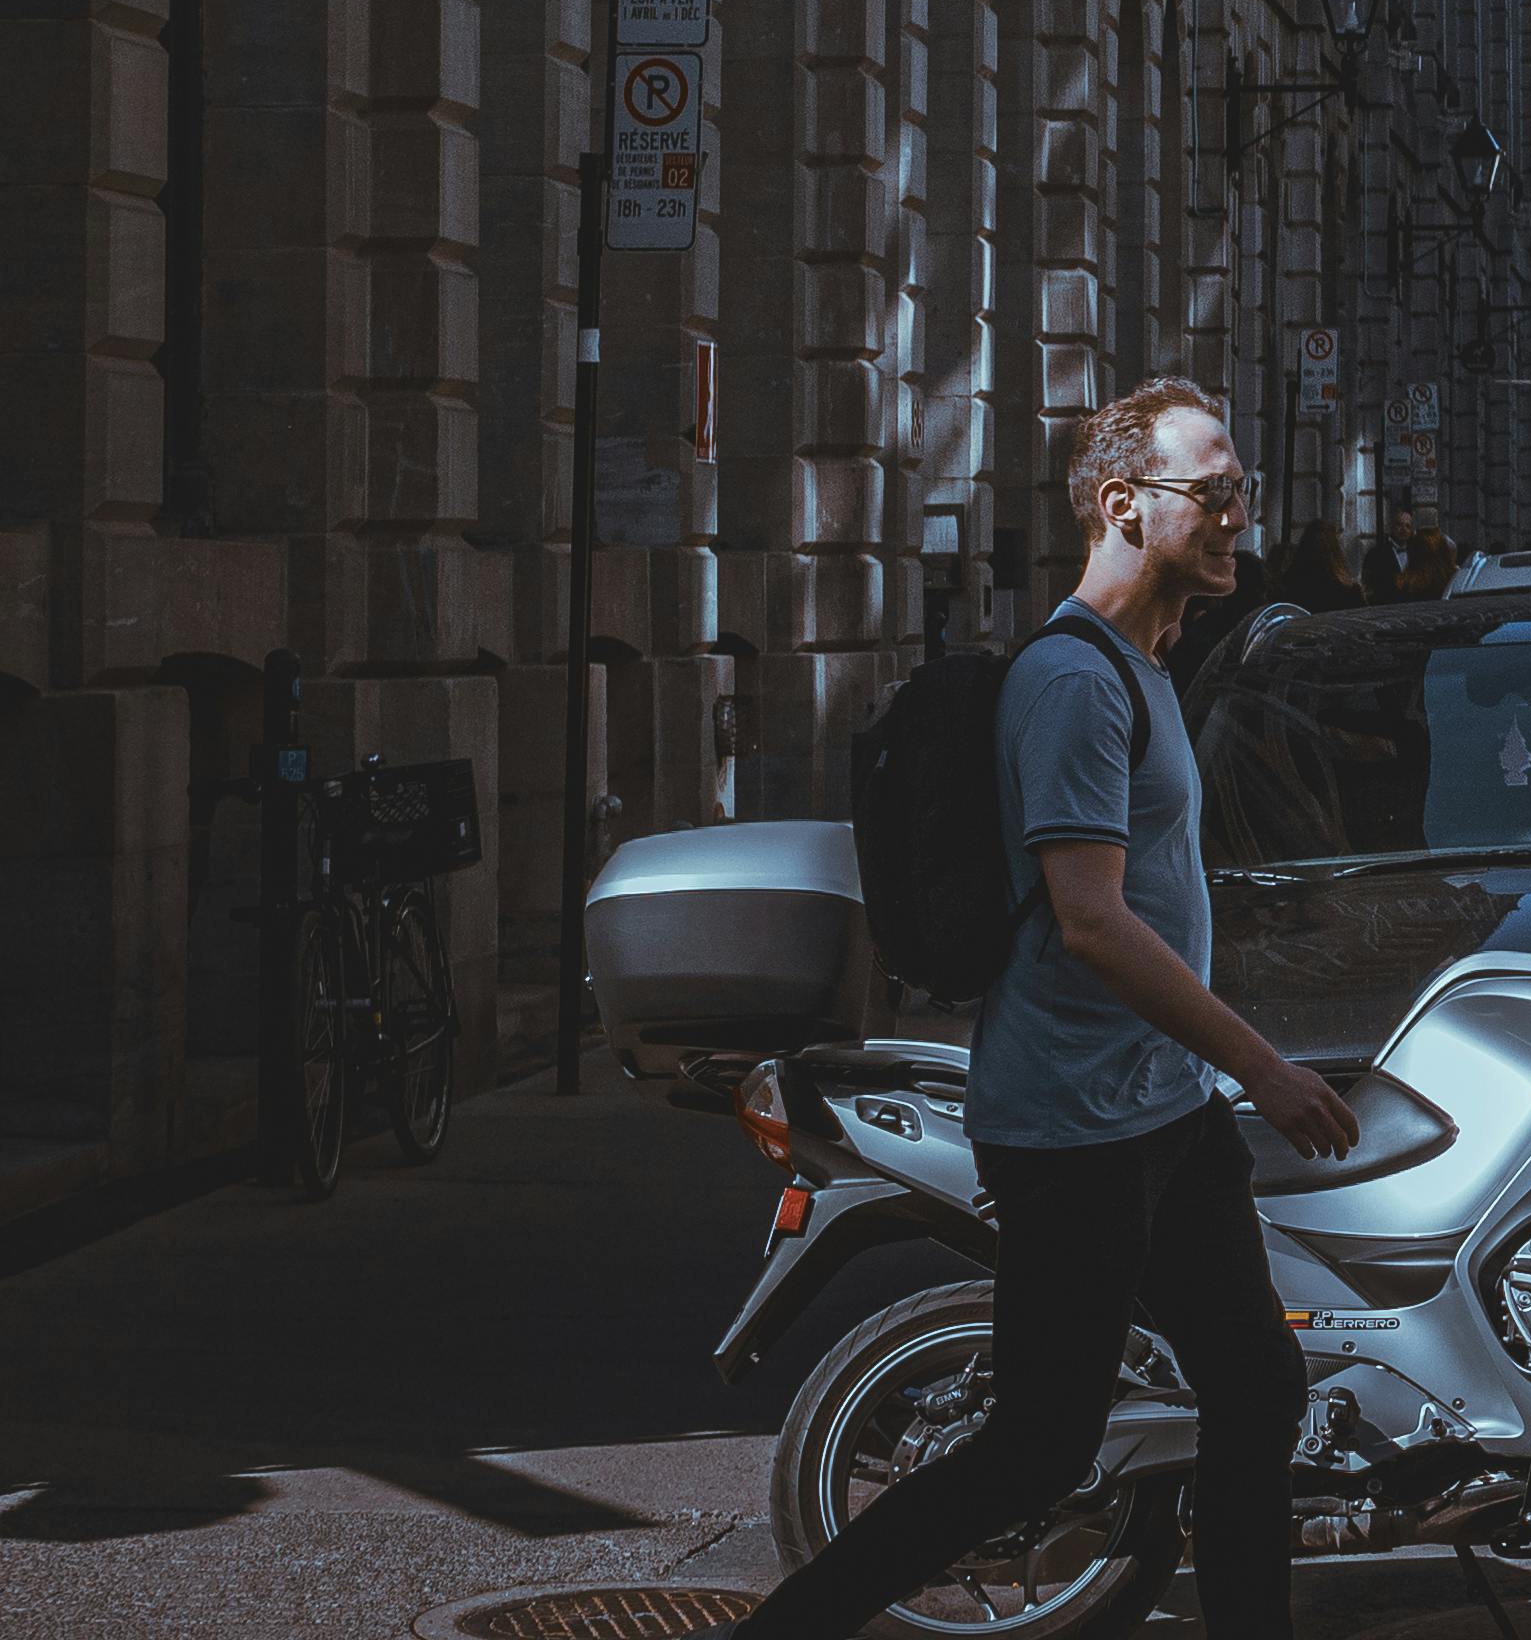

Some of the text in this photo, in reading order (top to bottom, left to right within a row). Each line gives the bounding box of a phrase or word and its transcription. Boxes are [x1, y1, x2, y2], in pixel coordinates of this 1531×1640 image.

[631, 7, 657, 20] AVRIL
[619, 128, 689, 150] RÉSERVÉ
[668, 167, 689, 187] 02
[617, 199, 641, 217] 18h
[656, 198, 686, 217] 23h
[1312, 1319, 1398, 1328] GUERRERO
